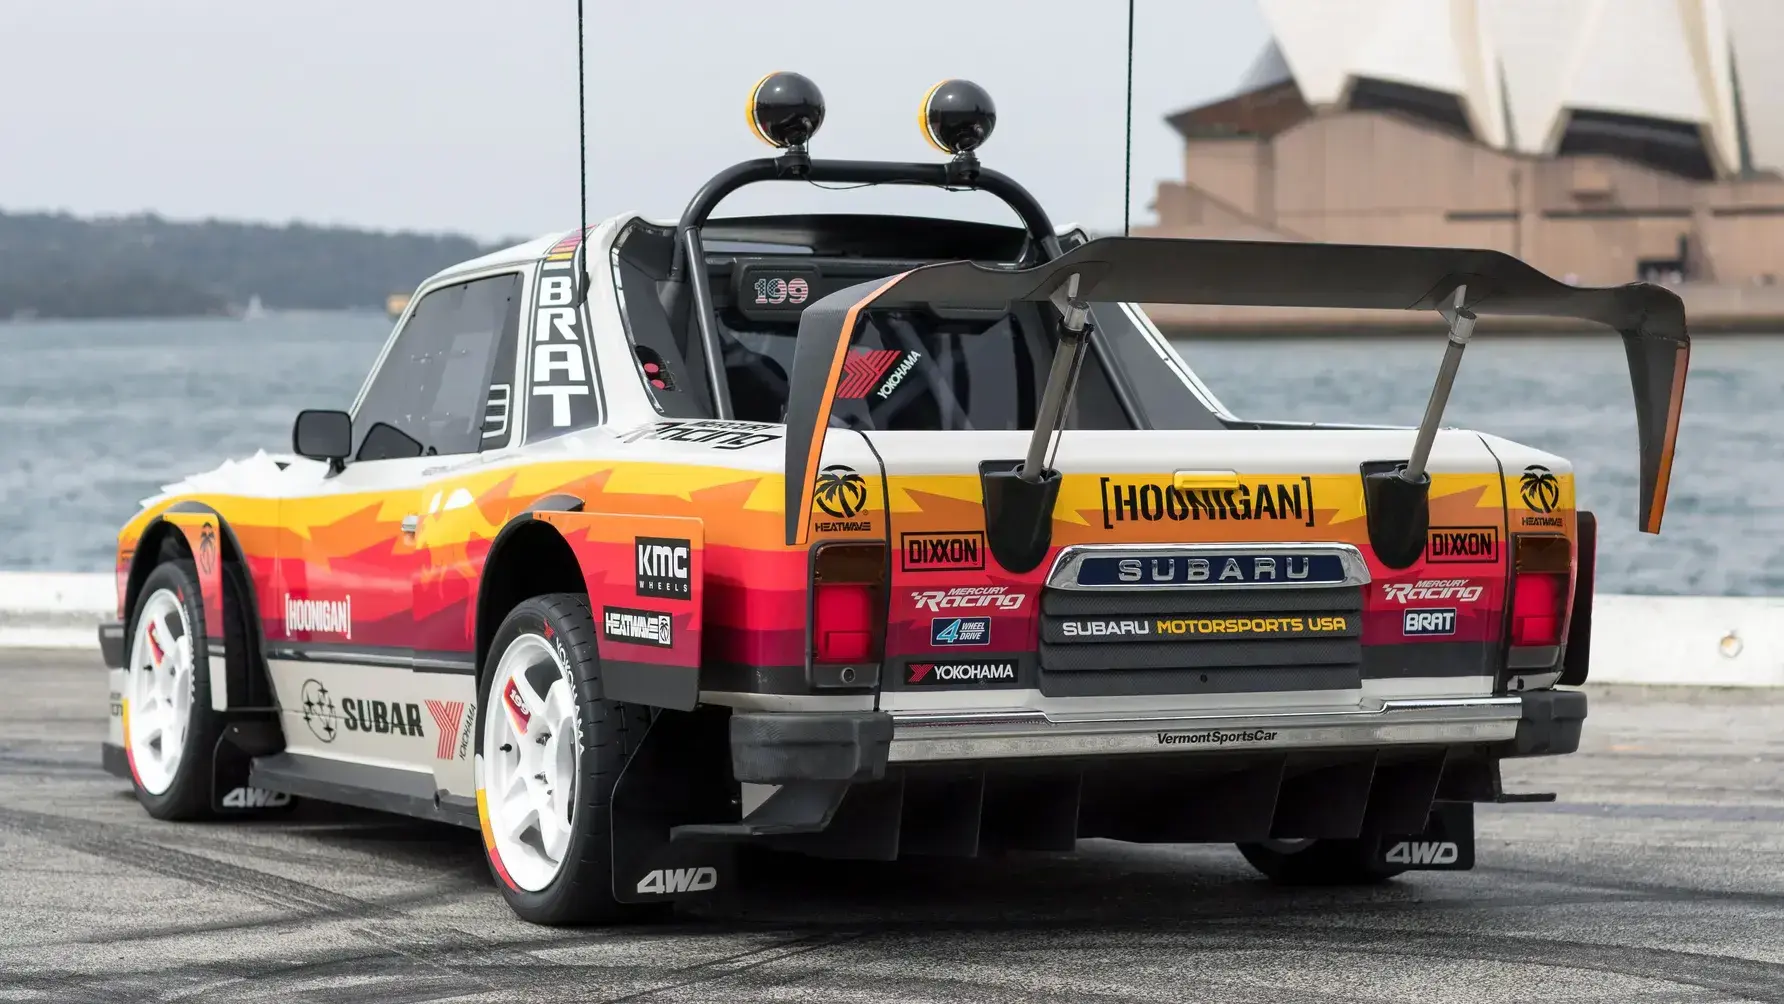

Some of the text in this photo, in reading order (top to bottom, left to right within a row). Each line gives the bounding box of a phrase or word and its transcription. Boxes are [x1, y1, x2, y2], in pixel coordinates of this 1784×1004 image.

[755, 277, 809, 304] 199
[533, 276, 589, 427] BRAT
[877, 350, 921, 399] YOKOHAMA
[815, 522, 871, 532] HEATWAVE
[1522, 517, 1563, 527] HEATWAVE
[908, 538, 978, 564] DIXXON
[1431, 533, 1493, 557] DIXXON
[638, 544, 688, 579] KMC
[1118, 556, 1310, 583] SUBARU
[639, 580, 688, 593] WHEELS
[947, 586, 1009, 596] MERCURY
[1382, 583, 1484, 604] Racing
[1414, 579, 1469, 588] MERCURY
[911, 591, 1026, 612] Racing
[605, 611, 659, 641] HEATWAVE
[936, 618, 985, 643] 4 WHEEL
[1062, 616, 1347, 636] SUBARU MOTORSPORTS USA
[1405, 612, 1455, 632] BRAT
[959, 632, 982, 641] DRIVE
[934, 664, 1015, 680] YOKOHAMA
[509, 689, 530, 716] 199
[341, 698, 425, 738] SUBAR
[1157, 730, 1278, 744] VermontSportsCar
[1385, 841, 1459, 865] 4WD
[637, 866, 718, 894] 4WD
